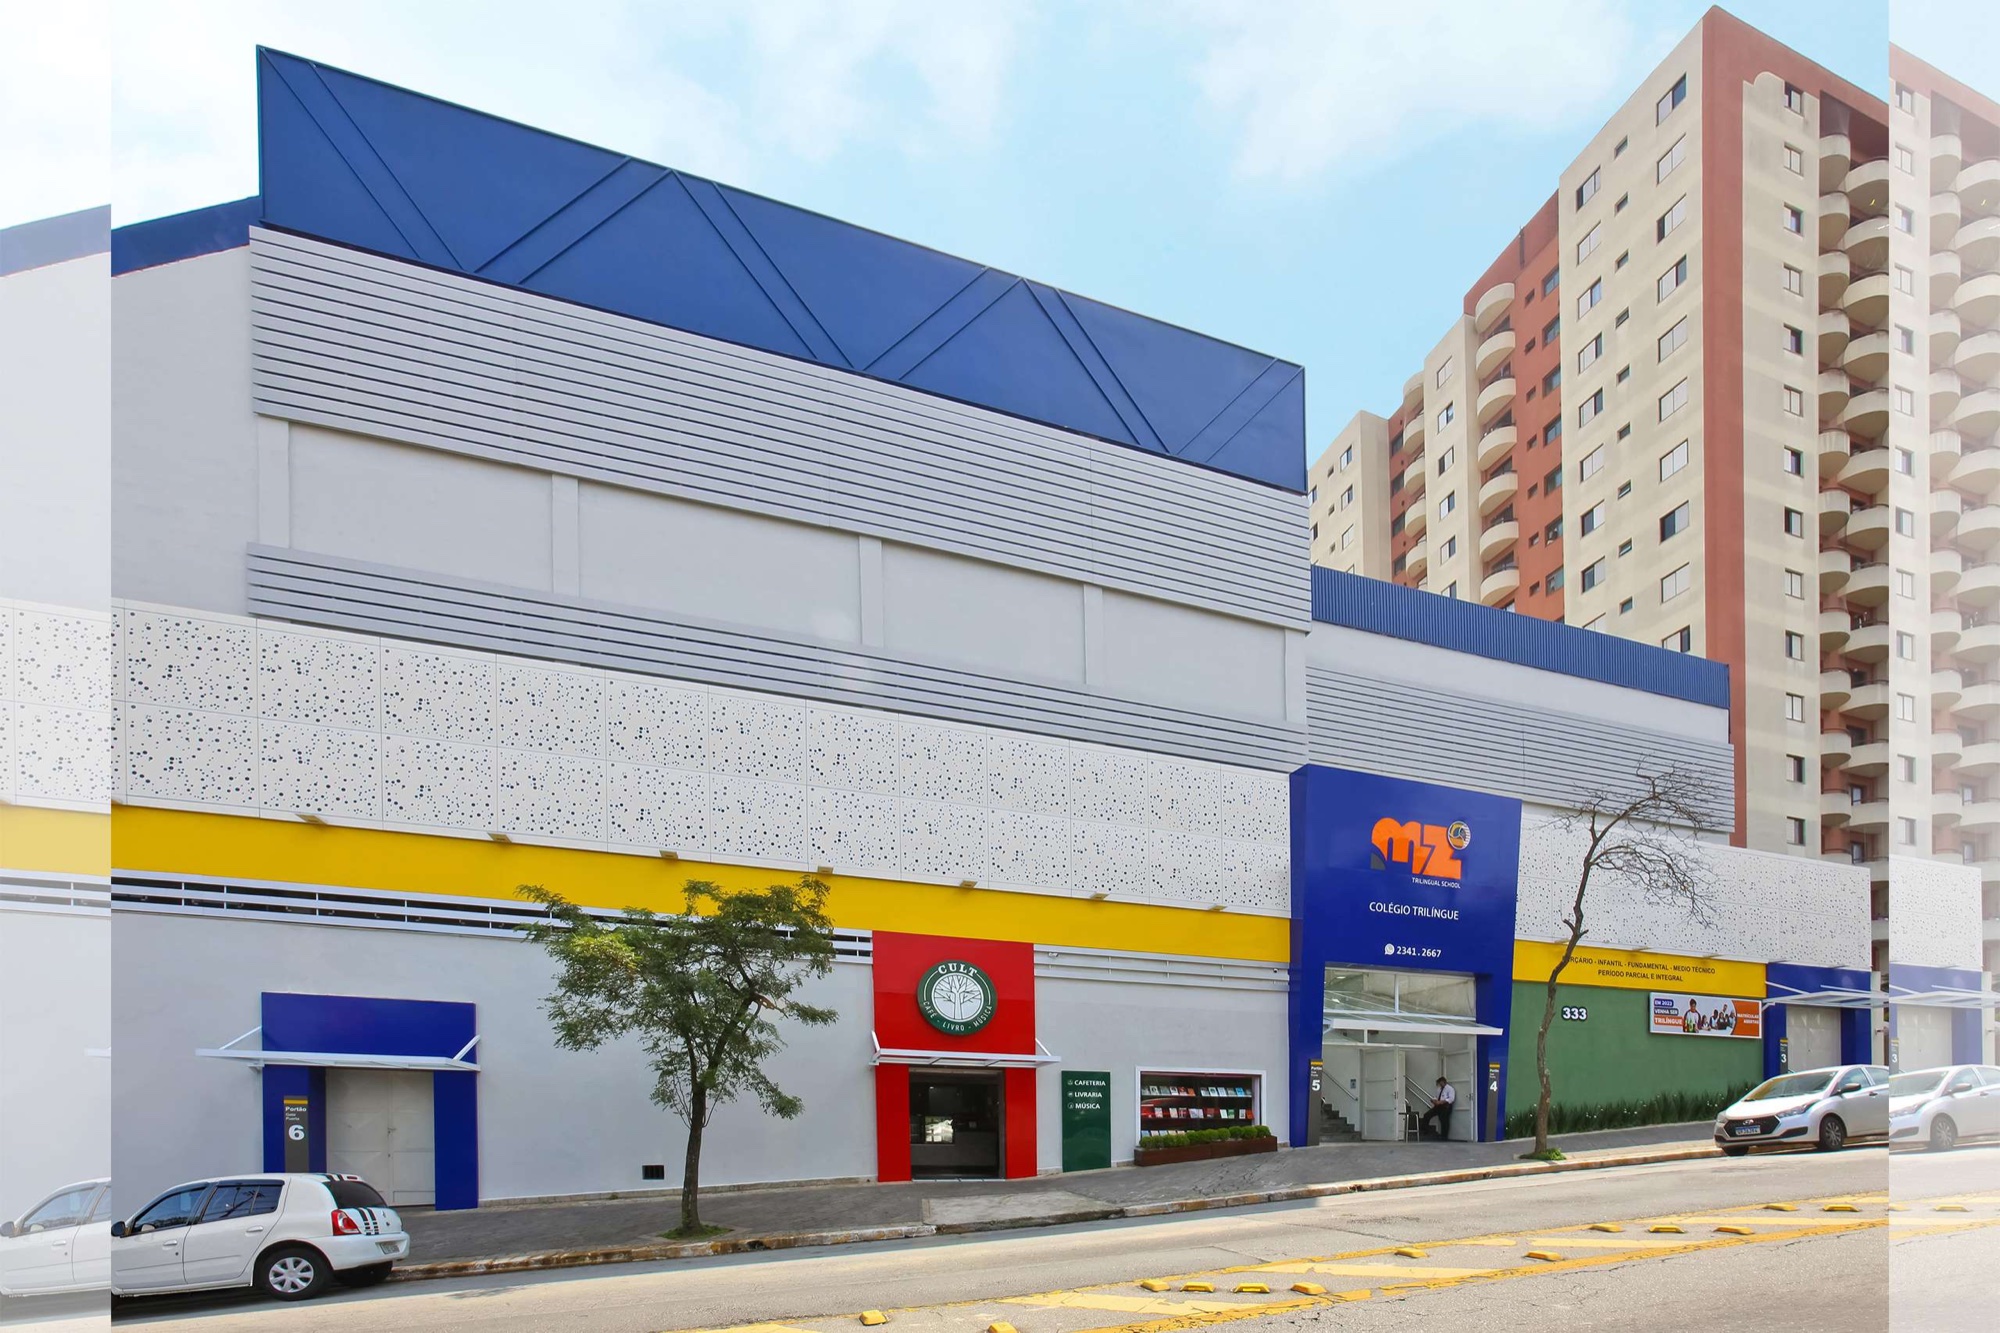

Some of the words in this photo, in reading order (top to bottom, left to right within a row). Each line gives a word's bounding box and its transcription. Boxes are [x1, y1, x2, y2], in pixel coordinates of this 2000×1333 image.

[1411, 876, 1441, 887] TRILINGUAL
[1441, 880, 1461, 889] SCHOOL
[1369, 901, 1411, 915] COLÉGIO
[1412, 905, 1459, 920] TRILÍNGUE
[937, 962, 978, 978] CULT
[1597, 959, 1623, 967] INFANTIL
[1627, 961, 1669, 971] FUNDAMENTAL
[1597, 969, 1625, 977] PERÍODO
[1625, 971, 1649, 980] PARCIAL
[1655, 974, 1683, 982] INTEGRAL
[923, 1001, 938, 1019] CAFÉ
[942, 1021, 965, 1032] LIVRO
[972, 1005, 993, 1028] MÚSICA
[1562, 1006, 1587, 1020] 333
[1781, 1053, 1787, 1063] 3
[1891, 1053, 1898, 1063] 3
[1311, 1079, 1321, 1091] 5
[1489, 1080, 1498, 1092] 4
[1075, 1102, 1101, 1110] MÚSICA
[288, 1124, 305, 1141] 6
